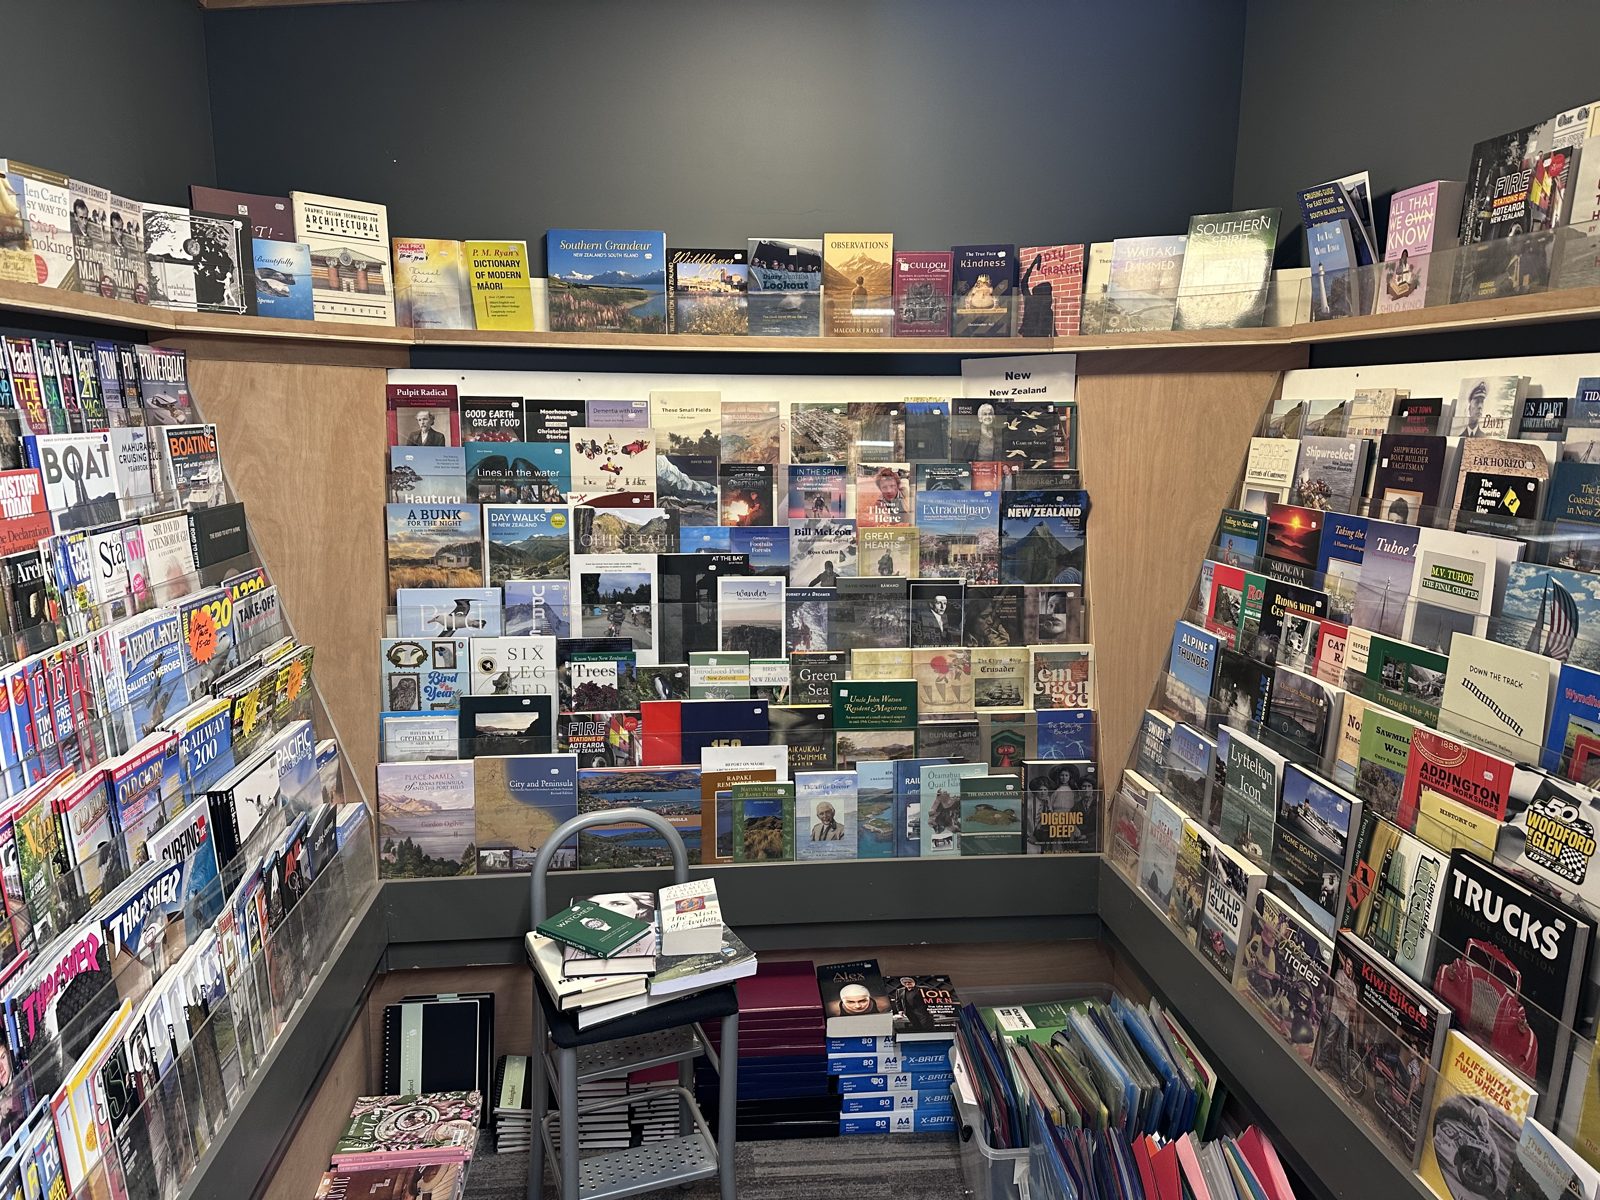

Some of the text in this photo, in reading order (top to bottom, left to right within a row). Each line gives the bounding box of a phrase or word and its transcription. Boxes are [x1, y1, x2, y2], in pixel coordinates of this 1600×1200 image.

[1494, 170, 1531, 198] FIRE
[38, 202, 68, 218] WAY TO
[1390, 193, 1434, 216] ALL THAT
[1491, 202, 1525, 218] AOTEAROA
[305, 215, 379, 232] ARCHITECTURAL
[1196, 218, 1271, 235] SOUTHERN
[560, 240, 651, 250] Southern Grandeur
[1389, 224, 1432, 250] KNOW
[255, 255, 295, 266] Beautifully
[474, 260, 520, 268] DICTIONARY
[960, 258, 1006, 267] Kindness
[1040, 262, 1082, 275] Graffiti
[78, 260, 101, 281] MAN
[476, 270, 521, 279] OF MODERN
[477, 281, 503, 290] MĀORI
[763, 280, 808, 289] Lookout
[139, 350, 185, 382] POWERBOAT
[1005, 371, 1031, 380] New
[397, 389, 419, 397] Pulpit
[1012, 387, 1047, 395] Zealand
[466, 410, 514, 418] GOOD EARTH
[1537, 401, 1564, 417] APART
[473, 419, 520, 427] GREAT FOOD
[1306, 446, 1355, 461] Shipwrecked
[1391, 454, 1428, 463] BOAT BUILDER
[1393, 446, 1427, 455] SHIPWRIGHT
[41, 444, 110, 484] BOAT
[1391, 461, 1424, 471] YACHTSMAN
[477, 469, 502, 477] Lines
[534, 469, 560, 477] water
[0, 474, 39, 500] HISTORY
[1481, 479, 1493, 488] The
[405, 494, 461, 504] Hauturu
[1479, 488, 1500, 498] Pacific
[1569, 494, 1591, 506] Coastal
[923, 505, 992, 515] Extraordinary
[1478, 498, 1495, 507] Forum
[408, 510, 461, 519] A BUNK
[491, 513, 546, 522] DAY WALKS
[1008, 508, 1081, 517] NEW ZEALAND
[12, 526, 49, 542] Declaration
[865, 541, 900, 549] HEARTS
[1377, 538, 1409, 556] Tuhoe
[1431, 567, 1473, 584] M.V. TUHOE
[1422, 580, 1479, 599] THE FINAL CHAPTER
[238, 594, 275, 623] TAKE-OFF
[1275, 594, 1315, 614] RIDING WITH
[1182, 633, 1208, 653] ALPINE
[507, 647, 544, 660] SIX
[1177, 646, 1210, 671] THUNDER
[428, 671, 458, 686] Bird
[507, 666, 545, 678] LEG
[573, 664, 615, 677] Trees
[800, 669, 837, 681] Green
[1469, 665, 1523, 689] DOWN THE TRACK
[808, 684, 829, 695] Sea
[182, 719, 227, 755] RAILWAY
[568, 723, 605, 735] FIRE
[195, 740, 218, 771] 200
[276, 728, 311, 769] PACIFIC
[797, 753, 826, 761] SWIMMER
[1231, 743, 1273, 785] Lyttelton
[1240, 774, 1262, 802] Icon
[1420, 762, 1500, 801] ADDINGTON
[119, 779, 138, 803] OLD
[1420, 772, 1499, 811] RAILWAY WORKSHOPS
[1041, 812, 1083, 825] DIGGING
[1050, 825, 1075, 838] DEEP
[1527, 810, 1596, 857] WOODFORD
[1532, 829, 1563, 858] GLEN
[1210, 880, 1241, 913] PHILLIP
[110, 869, 181, 959] THRASHER
[556, 905, 594, 928] WATCHES
[1208, 891, 1238, 928] ISLAND
[1452, 868, 1561, 961] TRUCKS
[1285, 948, 1321, 987] Trades
[833, 971, 865, 981] Alex
[22, 932, 100, 1043] THRASHER
[1361, 963, 1387, 993] Kiwi
[1389, 986, 1428, 1029] Bikers
[1012, 1008, 1029, 1028] OLYMPIC
[908, 1055, 945, 1063] X-BRITE
[1458, 1051, 1511, 1097] A LIFE WITH
[1454, 1058, 1512, 1111] TWO WHEELS
